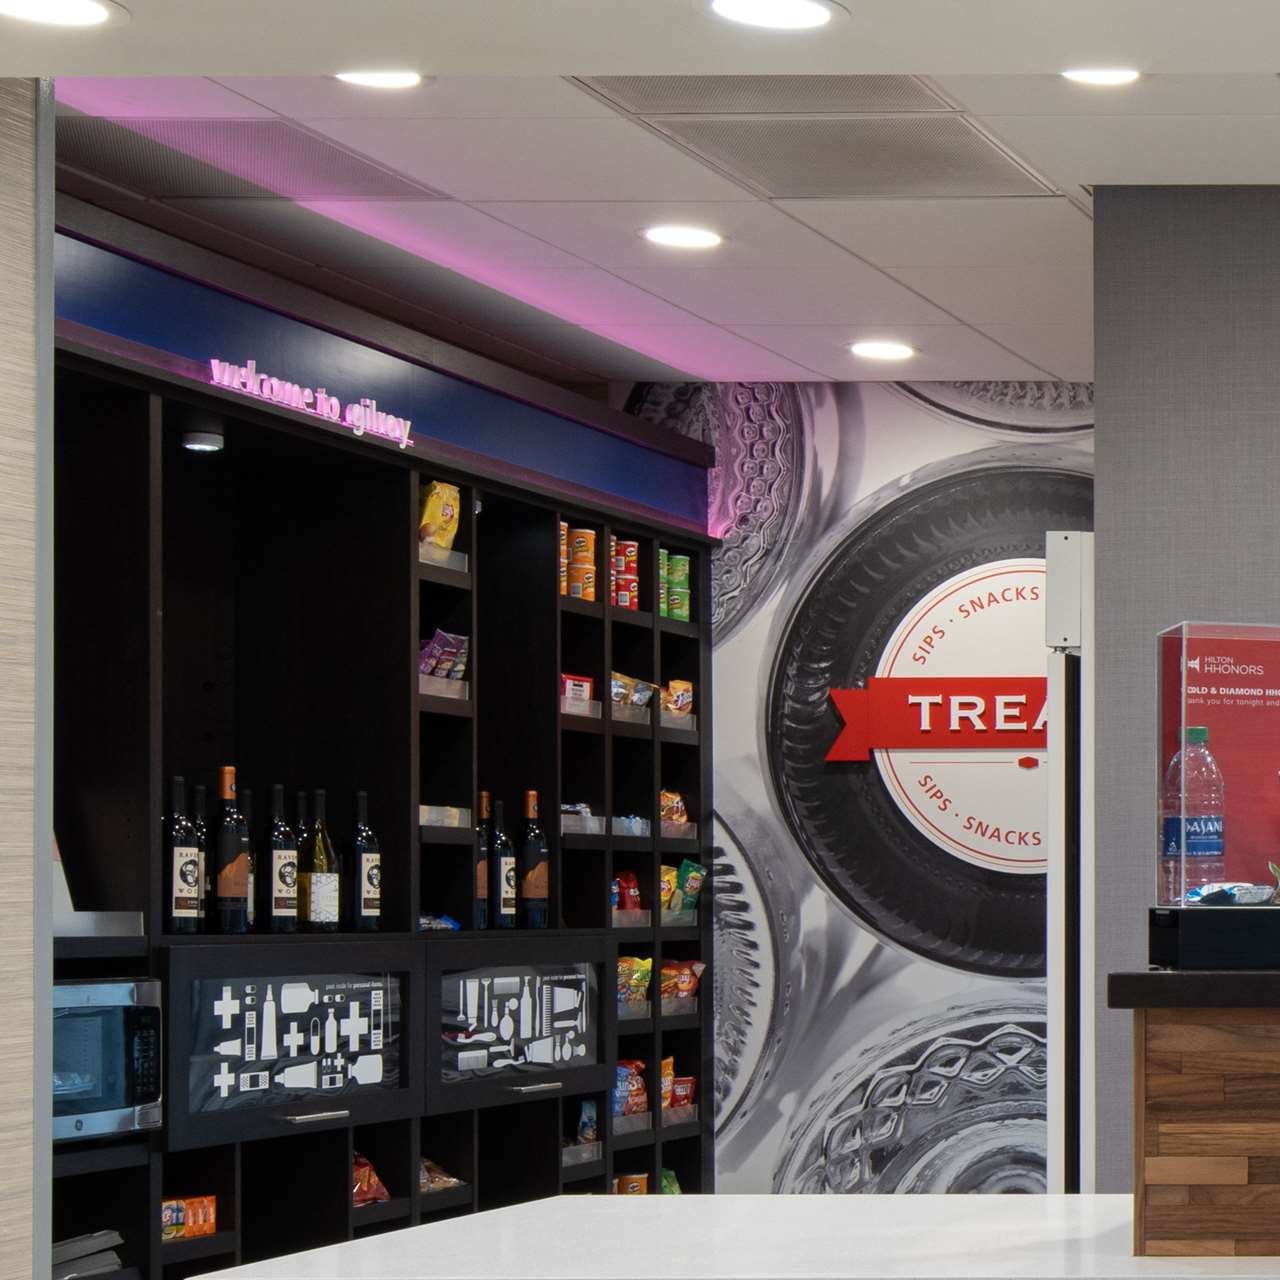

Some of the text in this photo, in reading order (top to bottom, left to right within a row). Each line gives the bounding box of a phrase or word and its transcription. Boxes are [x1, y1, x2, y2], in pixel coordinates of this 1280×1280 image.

[210, 358, 412, 449] welcome to gilroy
[912, 586, 1040, 665] SIPS SNACKS
[1205, 656, 1234, 664] HILTON
[1205, 663, 1265, 676] HHONORS
[1219, 687, 1264, 697] DIAMOND
[918, 774, 1042, 847] SIPS SNACKS
